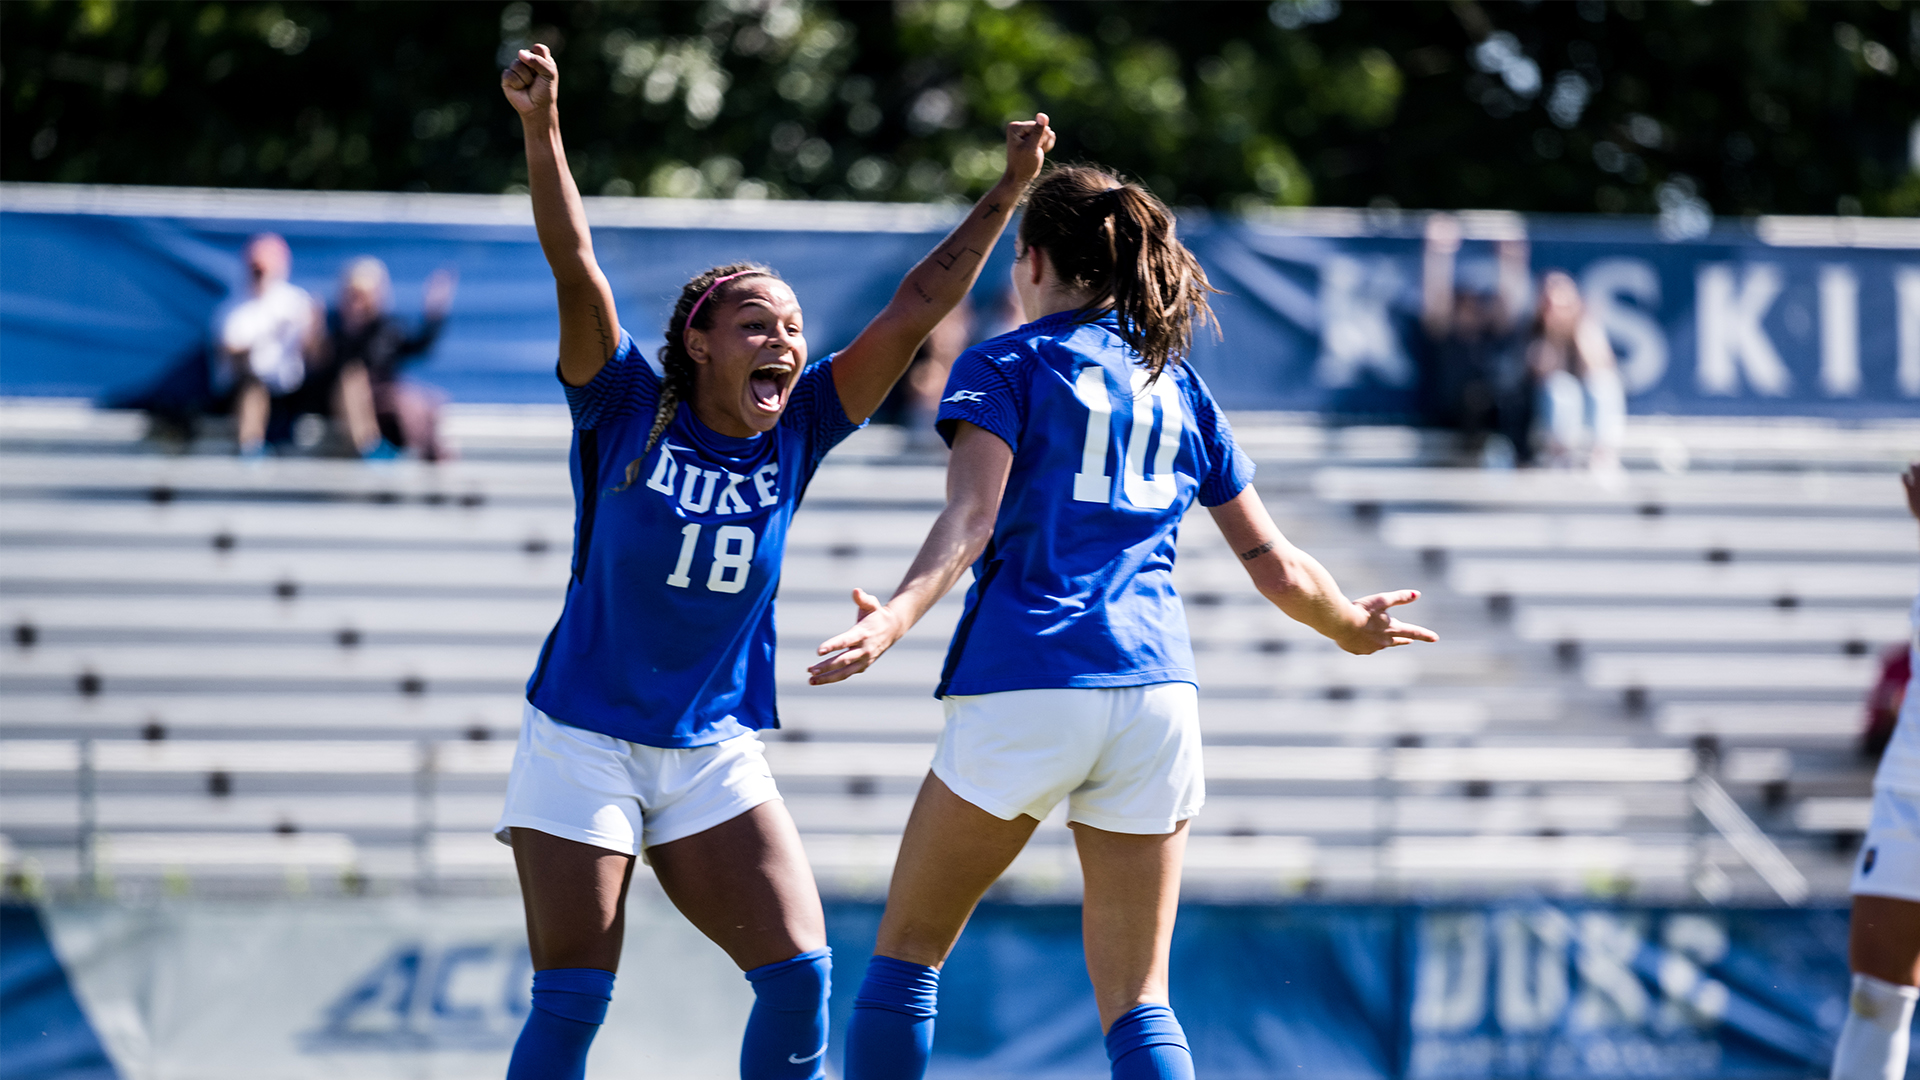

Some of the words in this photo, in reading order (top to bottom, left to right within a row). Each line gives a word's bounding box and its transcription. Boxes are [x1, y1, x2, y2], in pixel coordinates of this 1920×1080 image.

[1317, 254, 1920, 397] KSKI
[646, 443, 780, 515] DUKE
[1073, 366, 1182, 509] 10
[666, 523, 755, 594] 18
